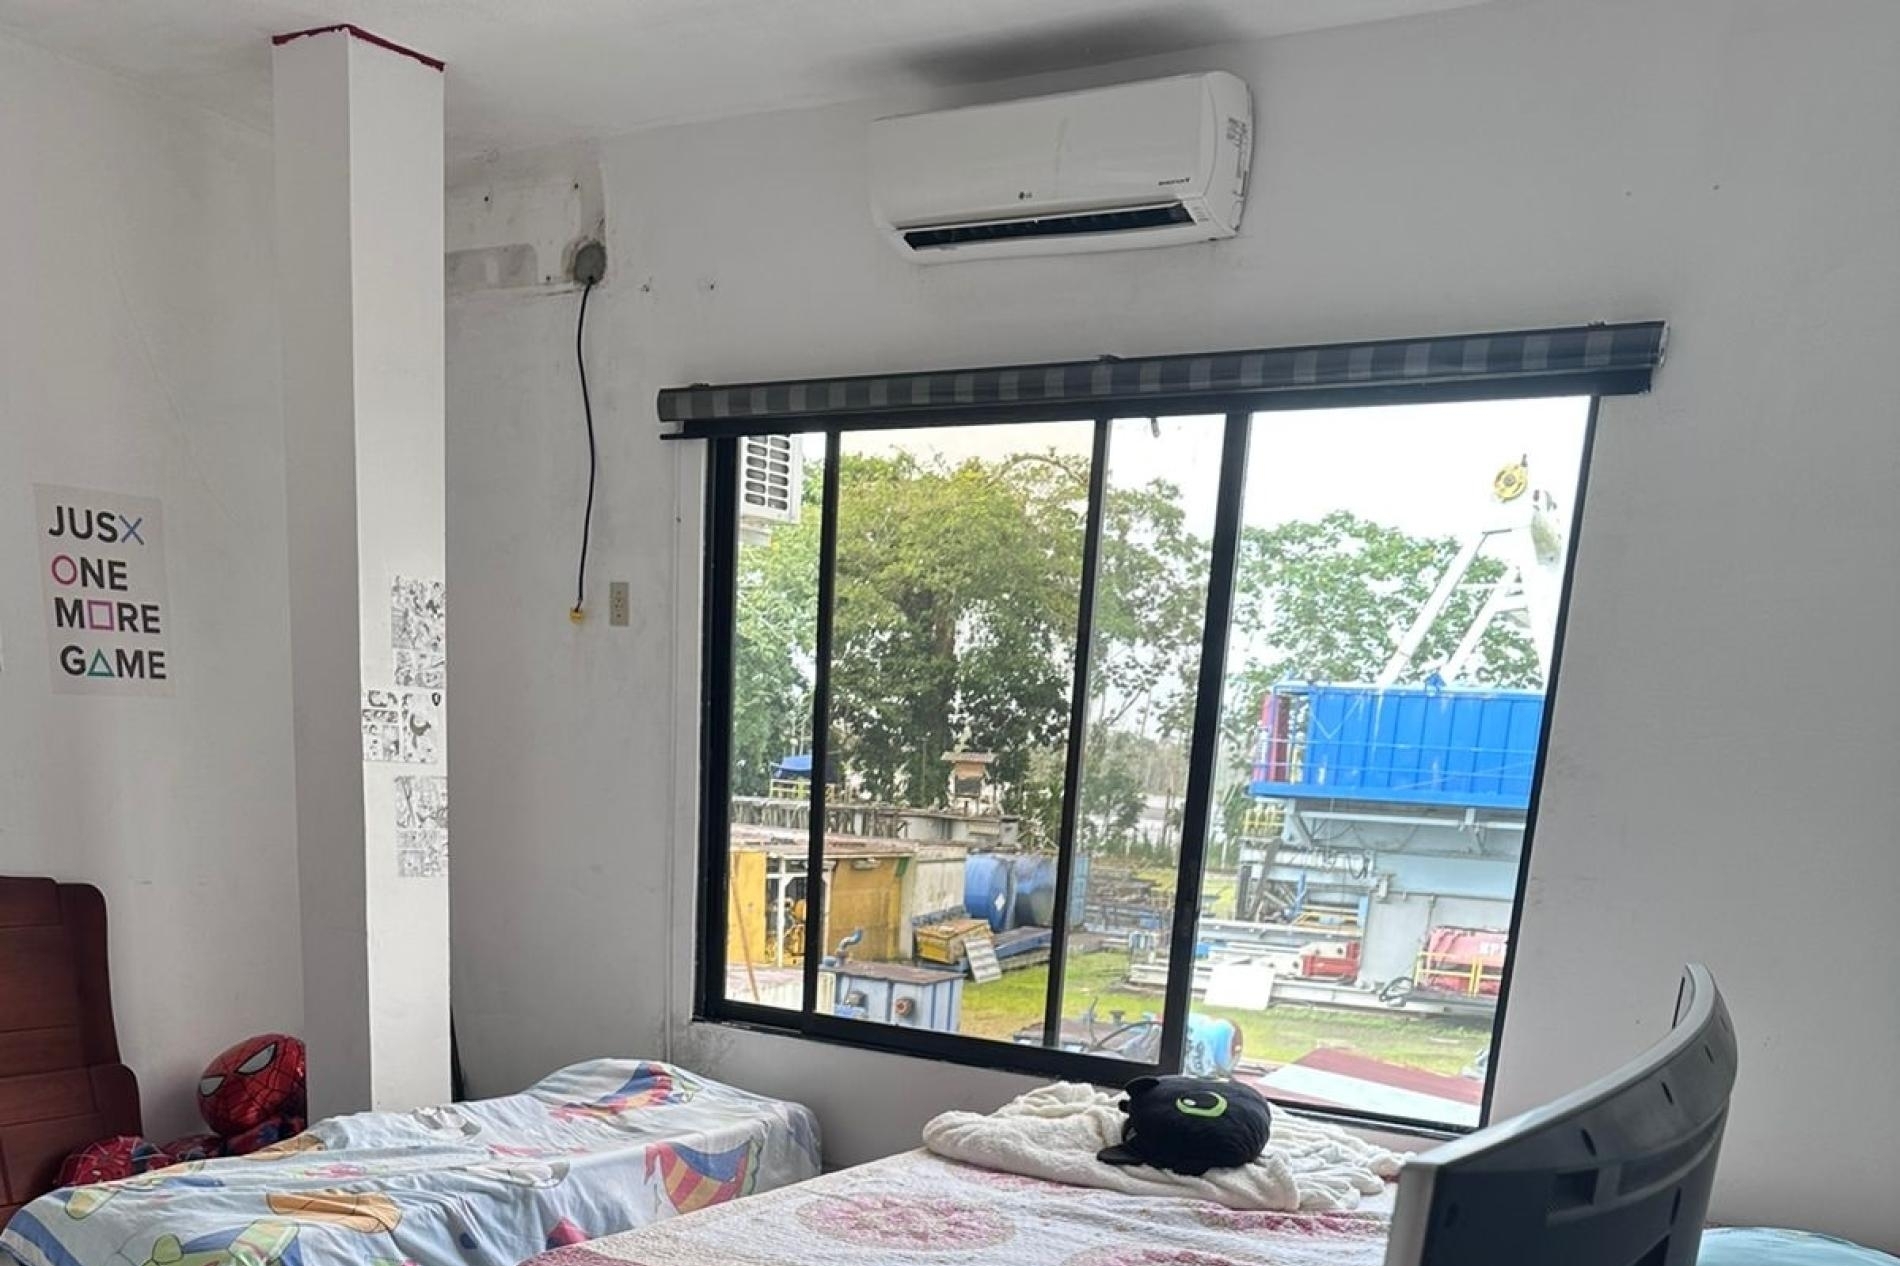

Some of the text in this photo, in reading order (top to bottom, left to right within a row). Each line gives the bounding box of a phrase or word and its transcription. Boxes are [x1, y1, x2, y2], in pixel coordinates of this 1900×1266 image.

[51, 555, 128, 591] ONE
[54, 597, 161, 634] MORE
[59, 645, 167, 680] GAME
